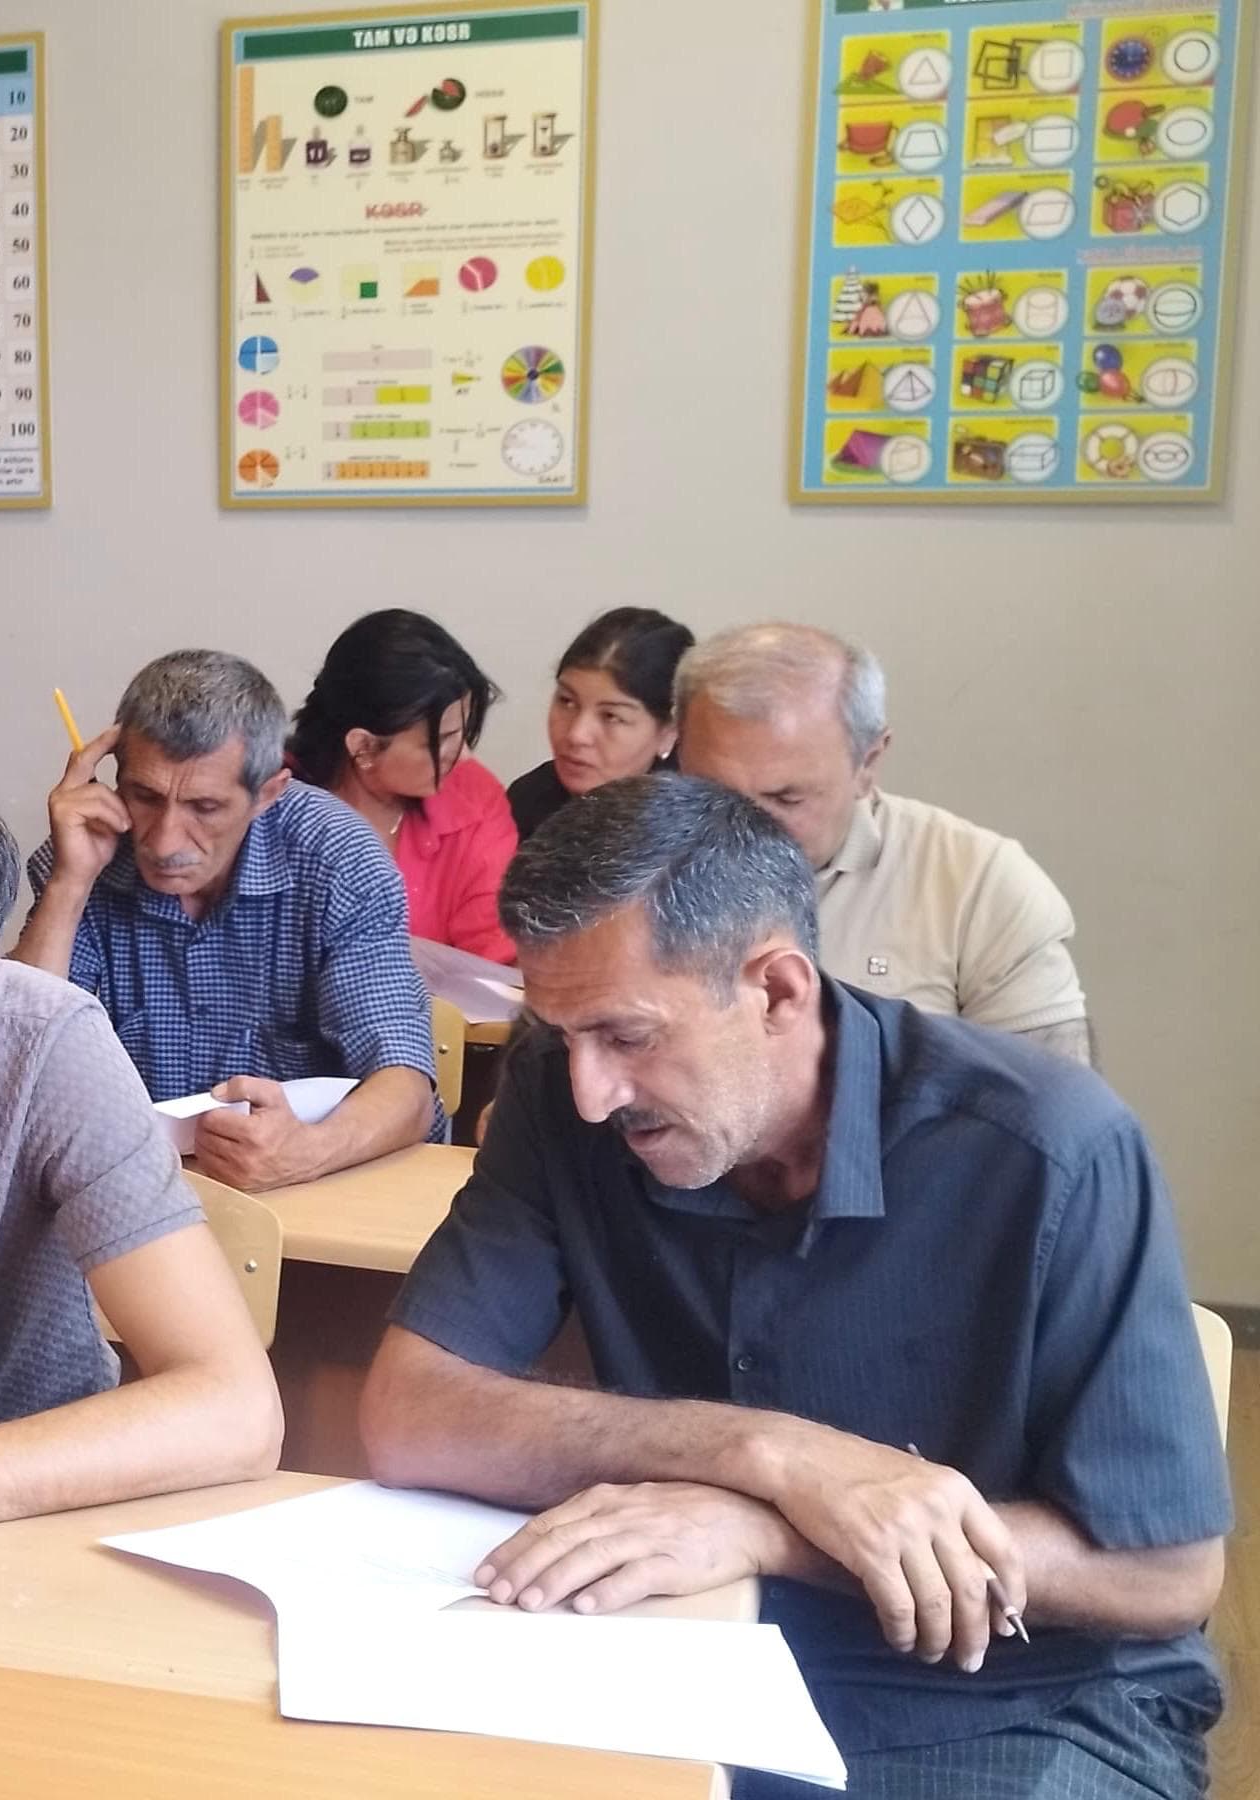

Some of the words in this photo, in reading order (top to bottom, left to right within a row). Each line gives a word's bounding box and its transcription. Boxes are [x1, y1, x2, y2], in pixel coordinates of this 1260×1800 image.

[352, 30, 391, 48] TAM
[393, 26, 418, 46] VƏ
[421, 22, 471, 43] KƏSR
[10, 90, 26, 105] 10
[11, 127, 28, 142] 20
[11, 164, 29, 177] 30
[12, 203, 29, 217] 40
[12, 238, 30, 252] 50
[13, 276, 30, 289] 60
[13, 313, 31, 327] 70
[14, 350, 32, 364] 80
[14, 387, 33, 401] 90
[11, 423, 36, 437] 100
